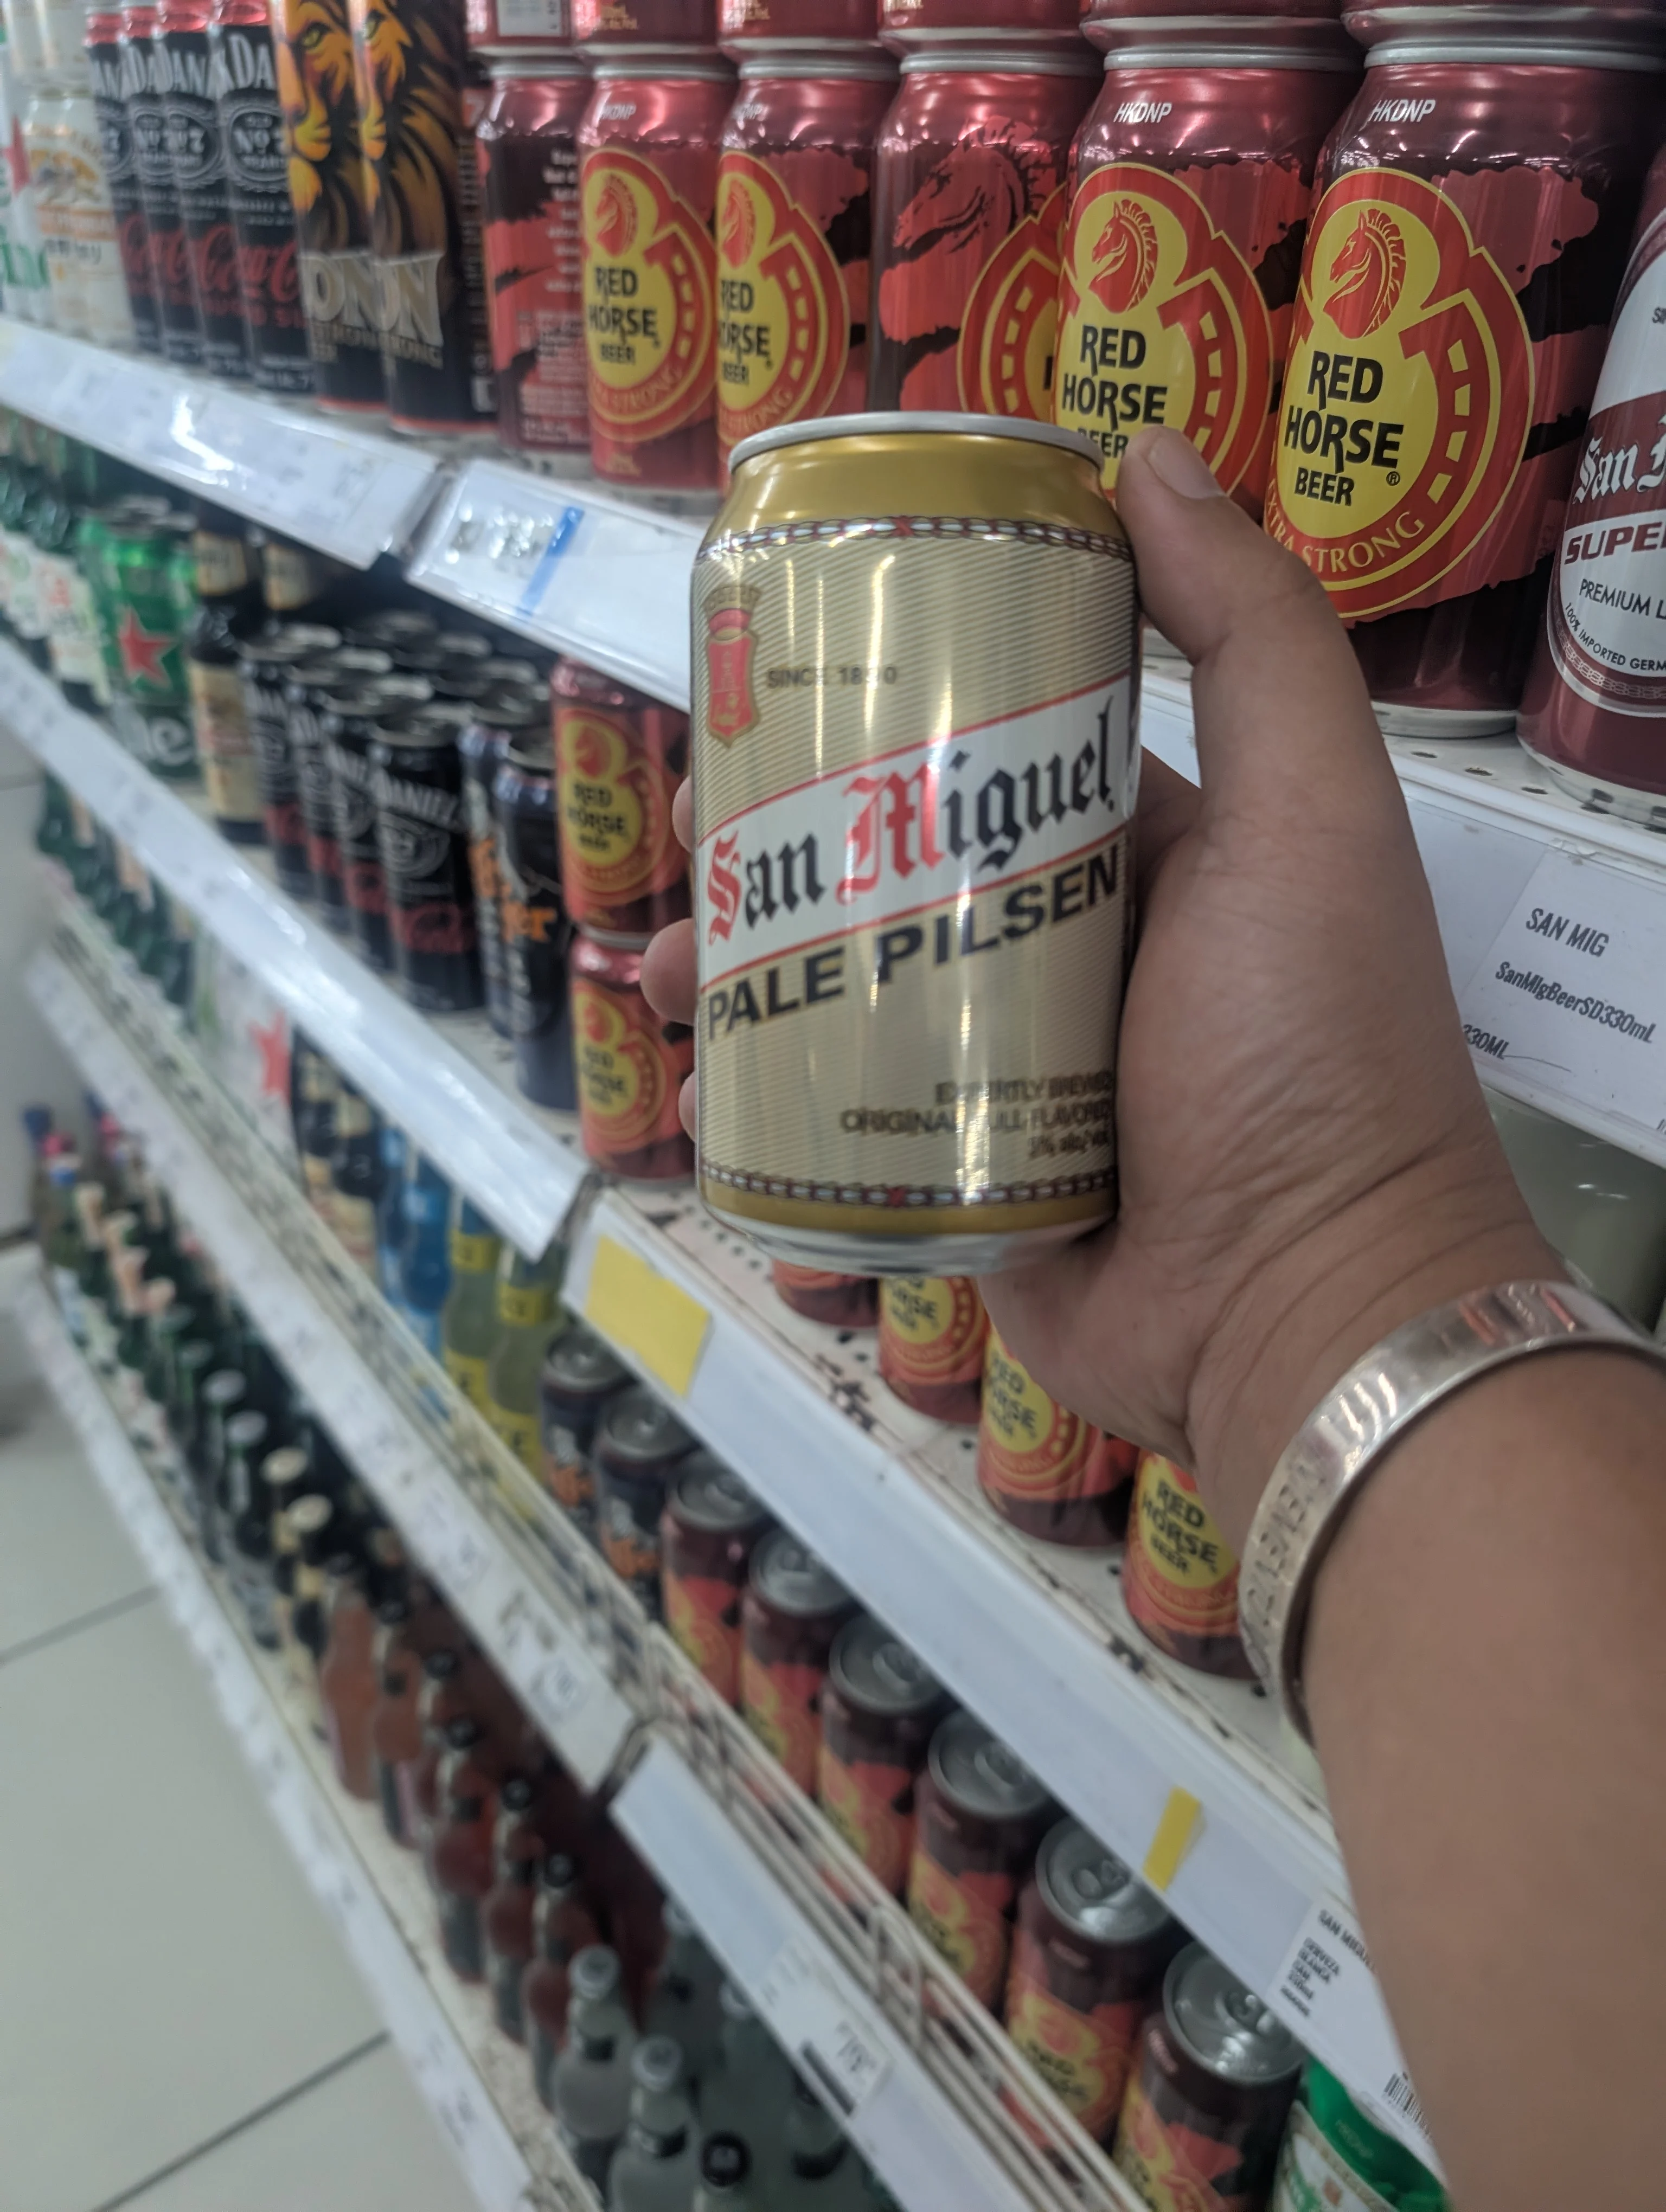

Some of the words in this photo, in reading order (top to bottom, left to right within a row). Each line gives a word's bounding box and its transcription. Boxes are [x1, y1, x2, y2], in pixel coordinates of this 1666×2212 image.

[1113, 102, 1172, 124] HKDNP
[1368, 99, 1436, 123] HKDNP
[595, 266, 639, 306] RED
[588, 305, 658, 346] HORSE
[1080, 324, 1146, 376] RED
[1062, 372, 1168, 433] HORSE
[1306, 350, 1384, 411] RED
[1283, 405, 1405, 474] HORSE
[1294, 466, 1355, 507] BEER
[1573, 436, 1639, 505] San
[1302, 511, 1426, 574] STRONG
[1564, 522, 1666, 565] SUPE
[1579, 578, 1652, 617] PREMIUM
[1565, 602, 1581, 632] 100%
[1578, 629, 1626, 666] IMPORTED
[838, 664, 899, 687] 180
[707, 828, 826, 947] San
[835, 695, 1116, 906] Miguel
[707, 945, 847, 1041] PALE
[876, 845, 1118, 983] PILSEN
[1525, 908, 1570, 941] SAN
[1566, 923, 1610, 957] MIG
[840, 1106, 960, 1136] ORIGINA
[1143, 1491, 1219, 1564] HORSE
[1157, 1478, 1205, 1530] RED
